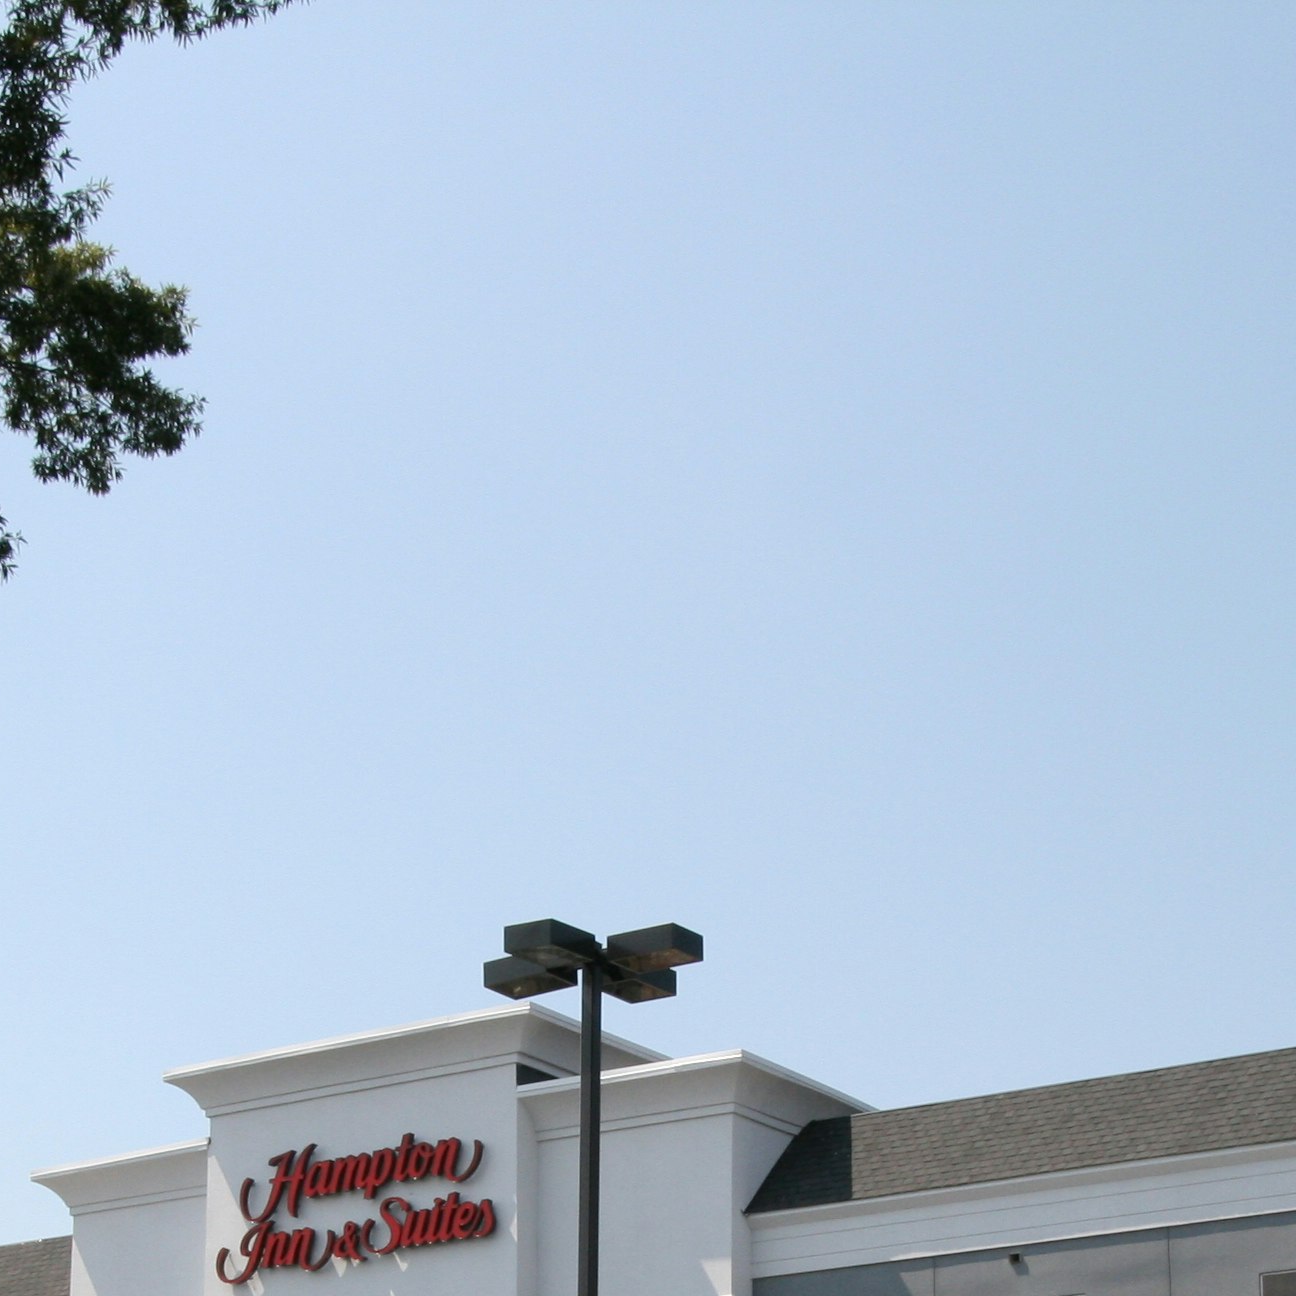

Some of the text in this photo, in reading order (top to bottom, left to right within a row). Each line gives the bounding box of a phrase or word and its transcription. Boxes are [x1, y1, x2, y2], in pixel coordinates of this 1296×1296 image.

[240, 1132, 484, 1223] Hampton
[216, 1191, 497, 1285] Inn & Suites
